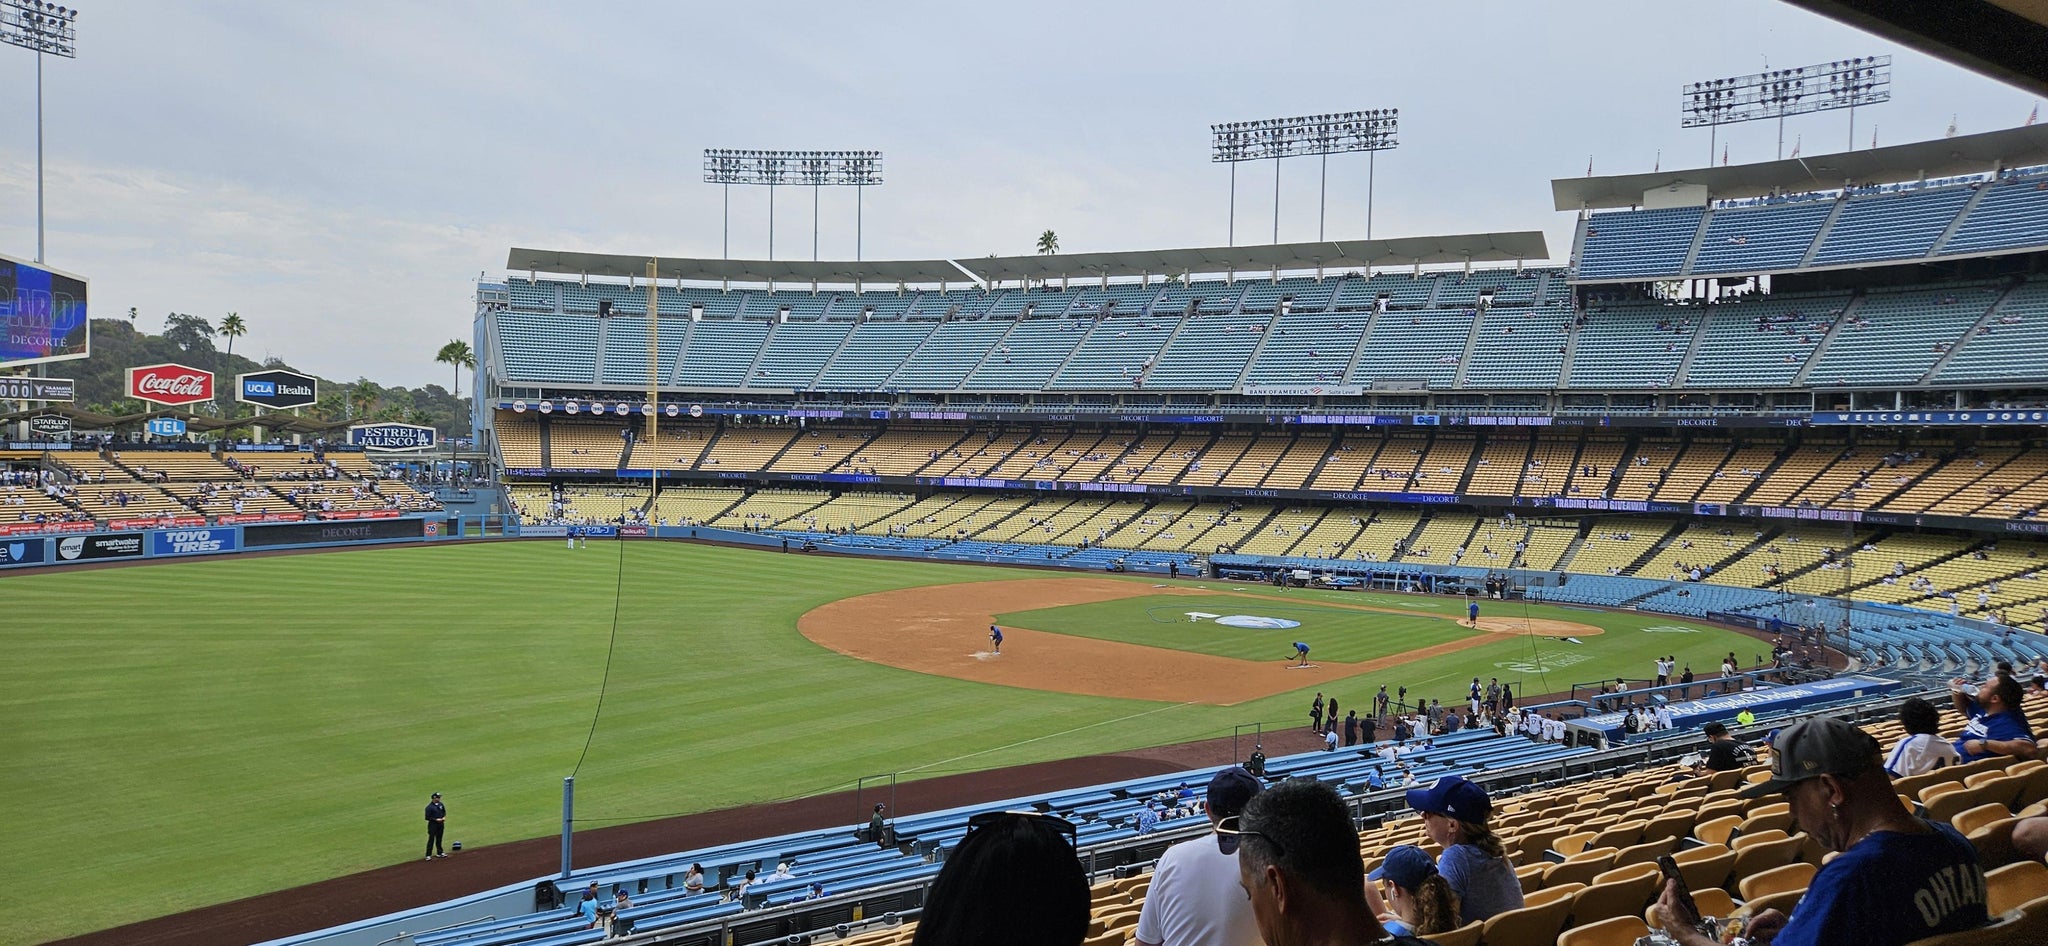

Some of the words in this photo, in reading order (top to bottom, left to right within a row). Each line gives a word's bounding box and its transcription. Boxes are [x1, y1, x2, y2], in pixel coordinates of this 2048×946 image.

[11, 385, 18, 397] 0
[22, 385, 29, 398] 0
[248, 382, 273, 394] UCLA
[278, 385, 312, 396] Health
[788, 410, 806, 418] RADING
[944, 412, 968, 420] GIVEAWAY
[1120, 414, 1149, 422] DECORTÉ
[1838, 413, 1932, 421] WELCOME
[1948, 413, 1970, 421] TO
[1301, 416, 1326, 424] TRADING
[1327, 416, 1344, 424] CARD
[1345, 416, 1376, 424] GIVEAWAY
[1468, 417, 1497, 425] TRADING
[1498, 417, 1516, 425] CARD
[1518, 417, 1553, 426] GIVEAWAY
[1677, 418, 1718, 426] DECORTÉ
[153, 421, 181, 433] TEL
[359, 438, 414, 447] JALISCO
[944, 478, 965, 486] TRADING
[966, 479, 979, 487] CARD
[980, 480, 1005, 488] GIVEAWAY
[1080, 482, 1103, 491] TRADING
[1104, 483, 1118, 492] CARD
[1119, 484, 1148, 493] GIVEAWAY
[1245, 489, 1278, 497] DECORTÉ
[1333, 492, 1368, 500] DECORTÉ
[1422, 495, 1460, 504] DECORTÉ
[1555, 499, 1587, 509] TRADING
[1588, 500, 1608, 510] CARD
[1609, 501, 1649, 512] GIVEAWAY
[1761, 507, 1796, 518] TRADING
[1797, 508, 1819, 520] CARD
[322, 525, 371, 538] DECORTÉ
[620, 527, 647, 535] Yakult
[166, 531, 211, 543] TOYO
[96, 539, 140, 547] smartwater
[173, 540, 221, 552] TIRES
